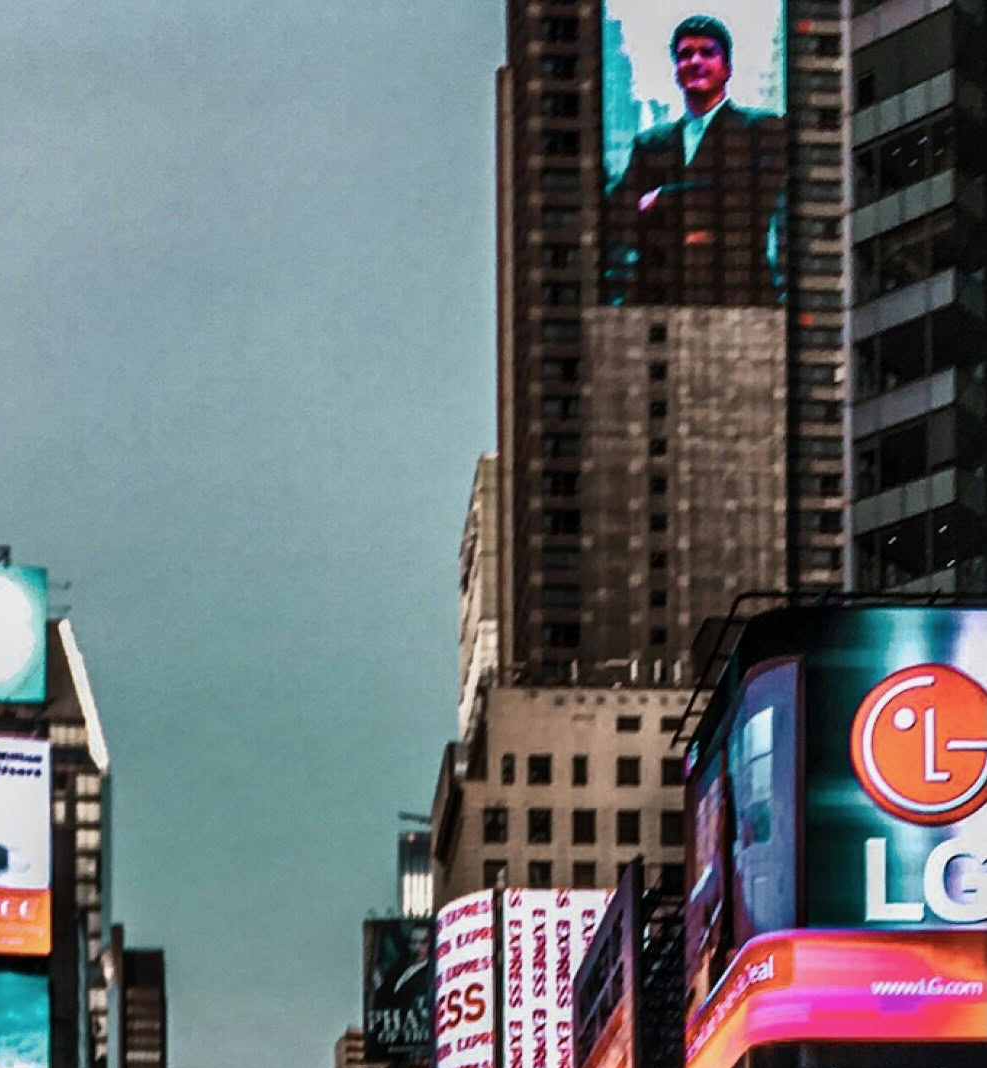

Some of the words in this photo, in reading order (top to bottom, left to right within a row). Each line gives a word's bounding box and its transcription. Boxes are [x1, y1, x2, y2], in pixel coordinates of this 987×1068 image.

[864, 837, 987, 925] LG
[508, 919, 523, 1008] EXPRESS
[532, 908, 547, 997] EXPRESS
[555, 919, 571, 1009] EXPRESS
[870, 976, 984, 997] www.LG.com
